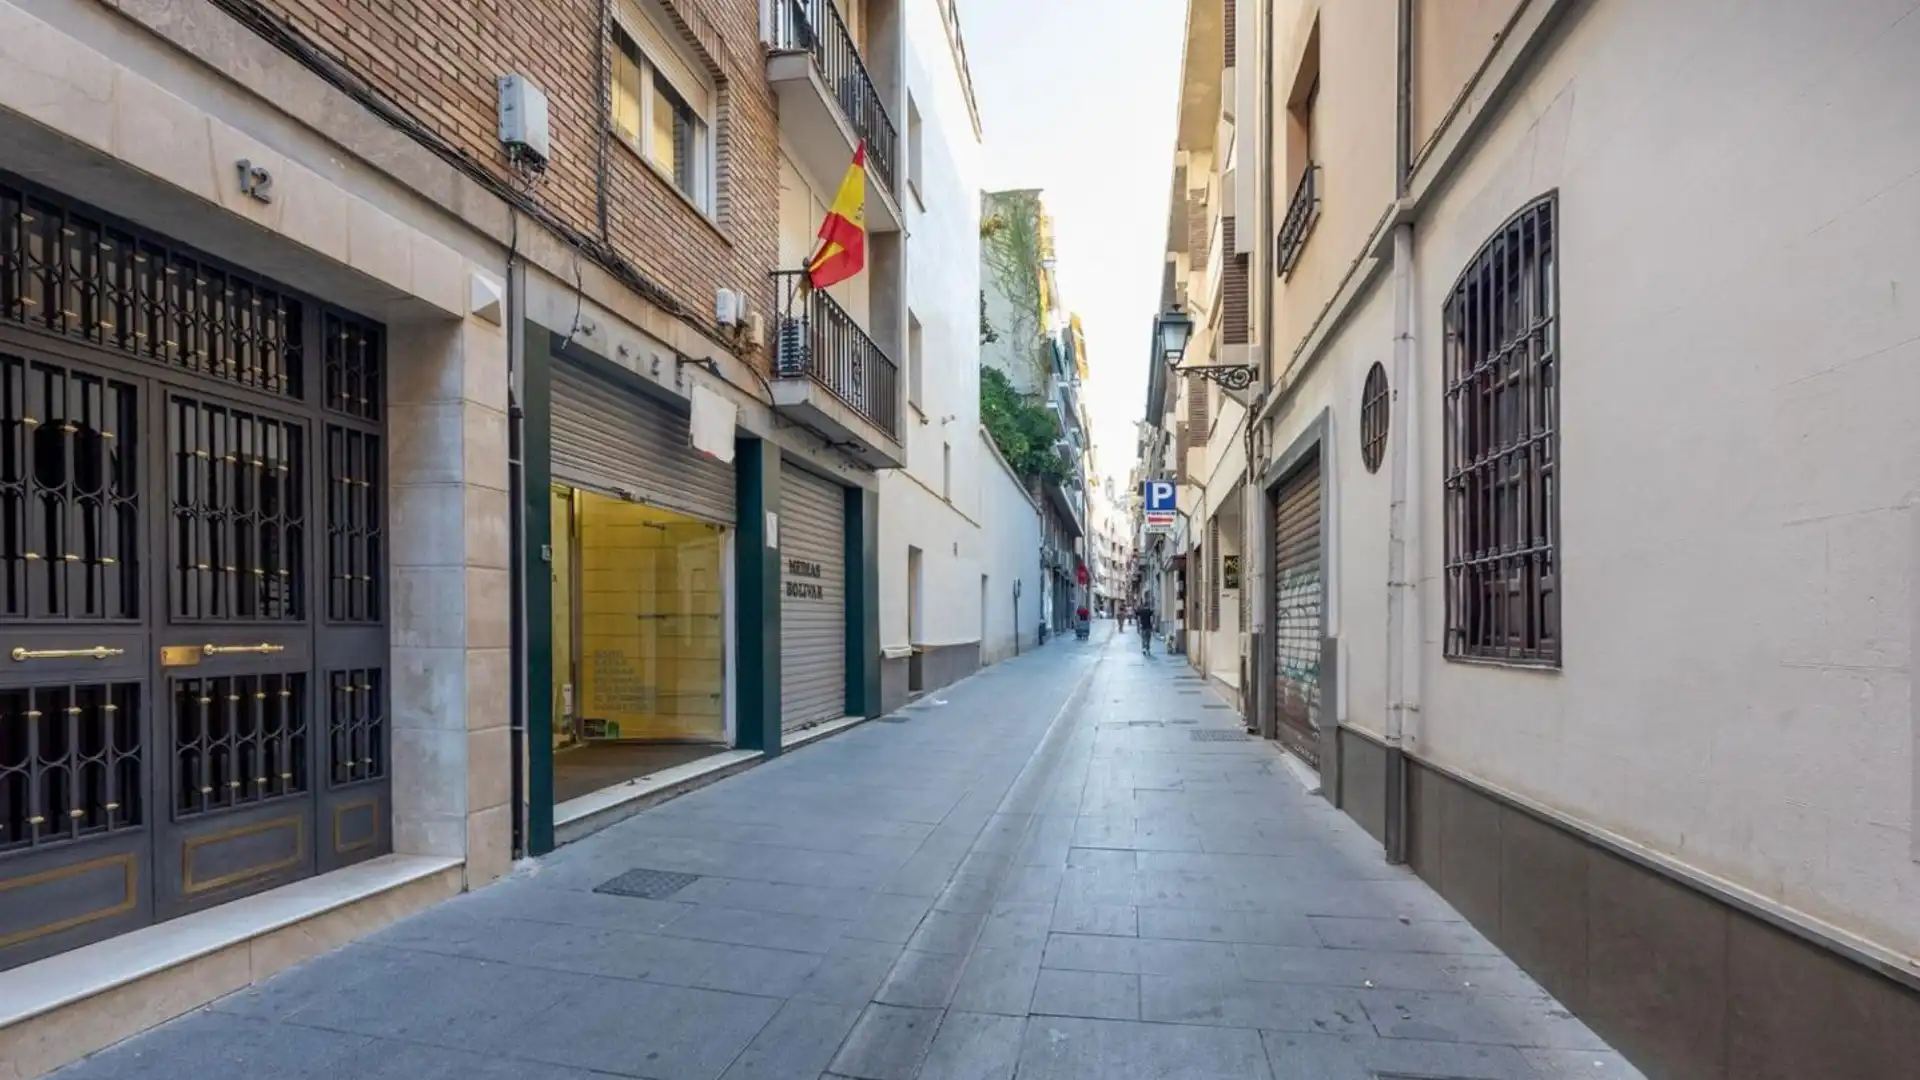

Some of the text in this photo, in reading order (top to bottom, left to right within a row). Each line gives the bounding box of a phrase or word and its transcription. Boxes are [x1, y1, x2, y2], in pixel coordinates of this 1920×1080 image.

[235, 158, 272, 204] 12
[1152, 483, 1174, 508] P
[788, 559, 821, 578] MEDIAS
[786, 581, 823, 600] BOLIVAR
